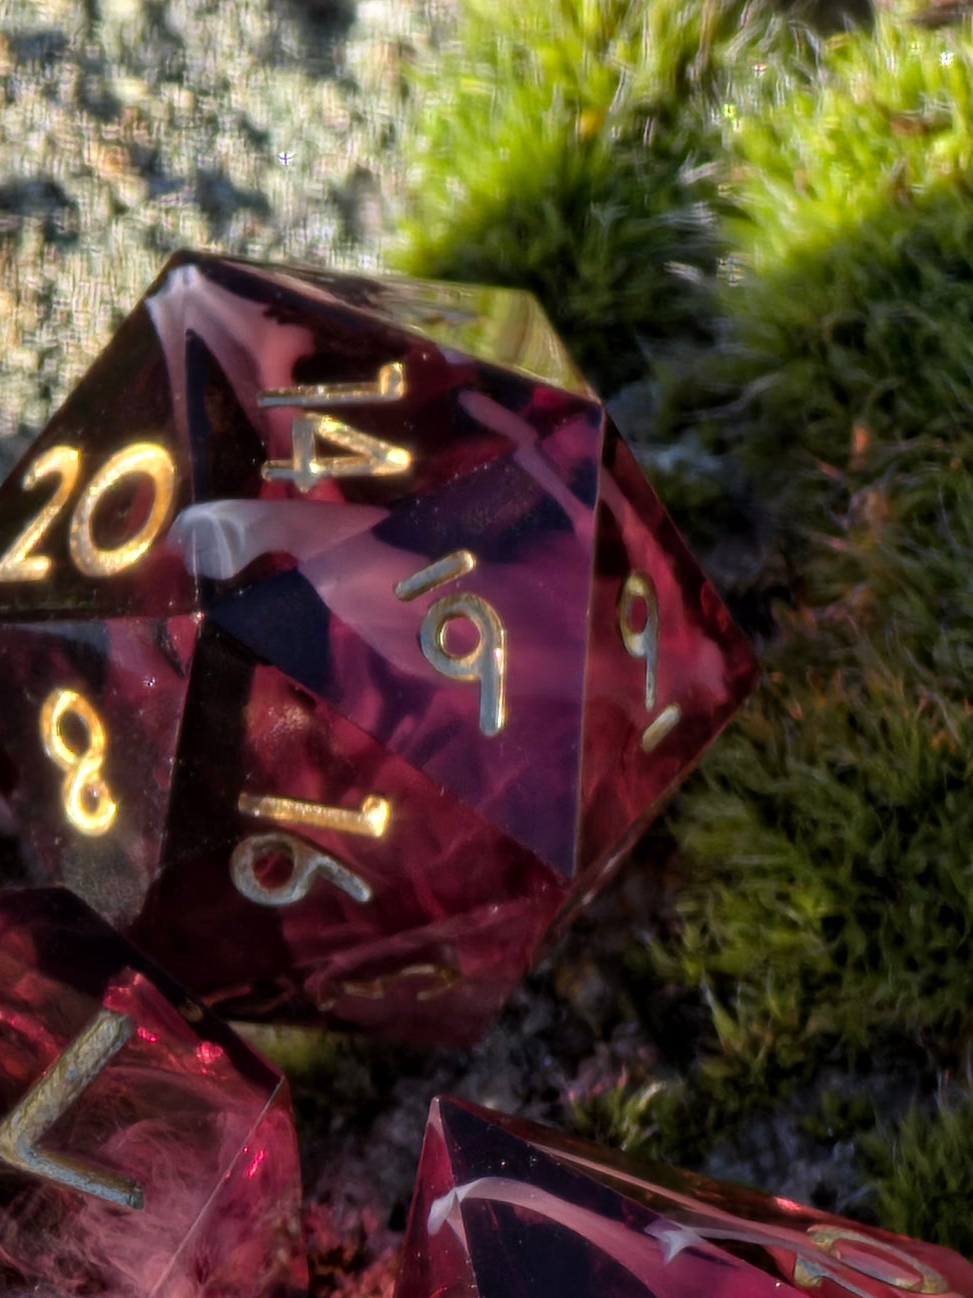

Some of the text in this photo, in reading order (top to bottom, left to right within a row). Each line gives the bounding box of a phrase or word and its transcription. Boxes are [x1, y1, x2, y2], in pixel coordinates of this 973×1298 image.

[258, 362, 413, 491] 14
[39, 689, 118, 836] 8
[230, 795, 391, 906] 16
